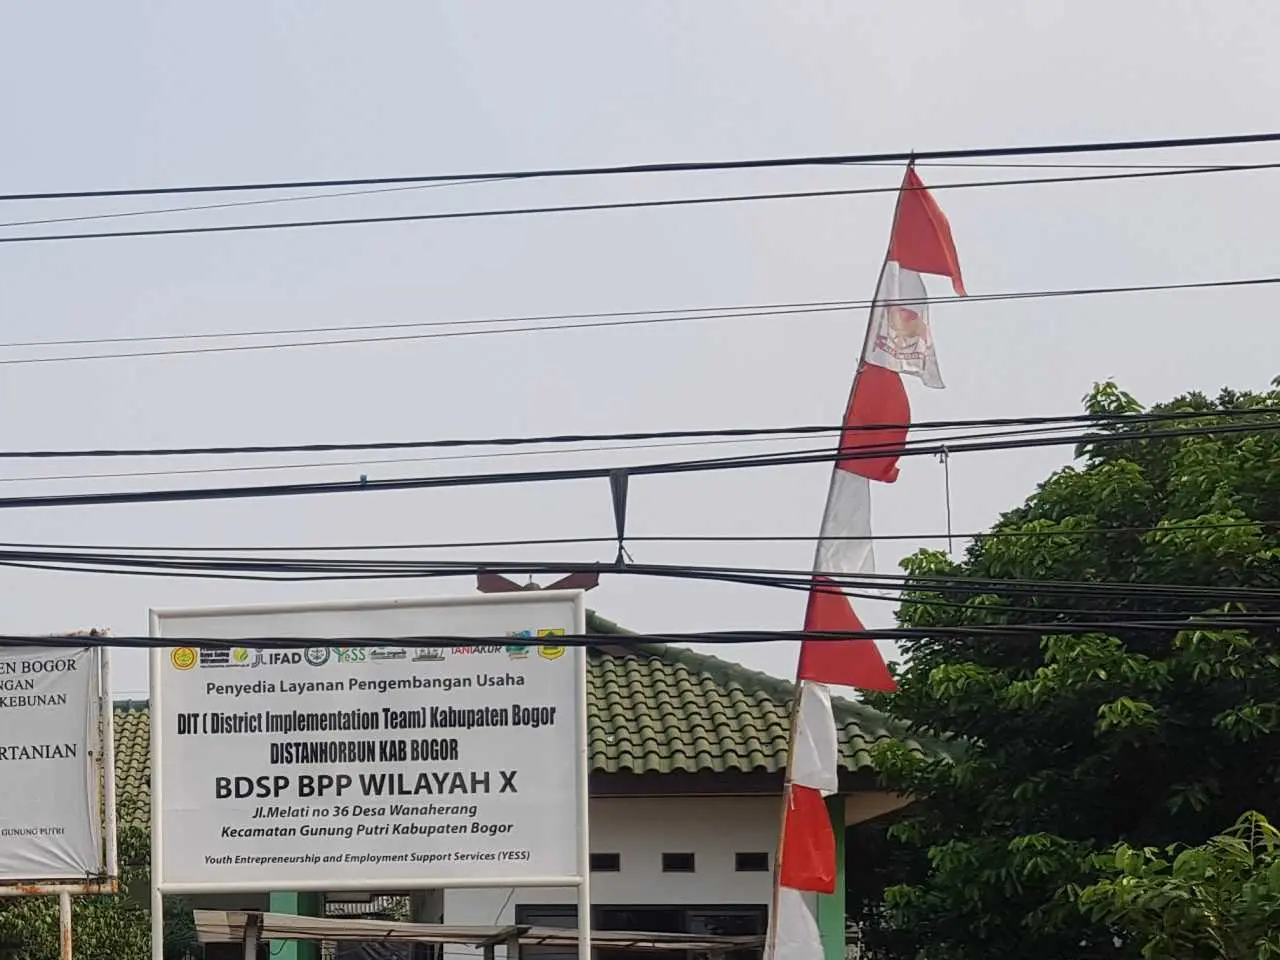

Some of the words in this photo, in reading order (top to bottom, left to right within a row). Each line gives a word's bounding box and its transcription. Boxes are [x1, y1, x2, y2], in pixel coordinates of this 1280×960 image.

[21, 659, 76, 673] BOGOR
[269, 653, 302, 665] IFAD
[207, 681, 275, 697] Penyedia
[280, 680, 344, 695] Layanan
[349, 676, 471, 693] Pengembangan
[476, 672, 525, 687] Usaha
[178, 713, 199, 734] DIT
[211, 712, 262, 734] District
[266, 709, 379, 734] Implementation
[430, 706, 508, 729] Kabupaten
[512, 704, 556, 728] Bogor
[271, 741, 375, 764] DISTANHORBUN
[379, 740, 407, 762] KAB
[411, 739, 458, 761] BOGOR
[216, 776, 289, 799] BDSP
[299, 775, 352, 797] BPP
[359, 772, 489, 796] WILAYAH
[499, 771, 517, 793] X
[311, 808, 330, 818] no
[332, 805, 350, 818] 36
[351, 804, 386, 817] Desa
[390, 803, 477, 817] Wanaherang
[1, 826, 39, 839] GUNUNG
[38, 826, 65, 836] PUTRI
[220, 826, 297, 838] Kecamatan
[299, 824, 354, 839] Gunung
[356, 823, 390, 836] Putri
[392, 823, 467, 837] Kabupaten
[471, 822, 513, 836] Bogor
[204, 855, 233, 865] Youth
[234, 853, 321, 866] Entrepreneurship
[322, 853, 344, 863] and
[343, 852, 409, 865] Employment
[409, 852, 453, 864] Support
[453, 851, 497, 861] Services
[497, 850, 531, 862] (YESS)
